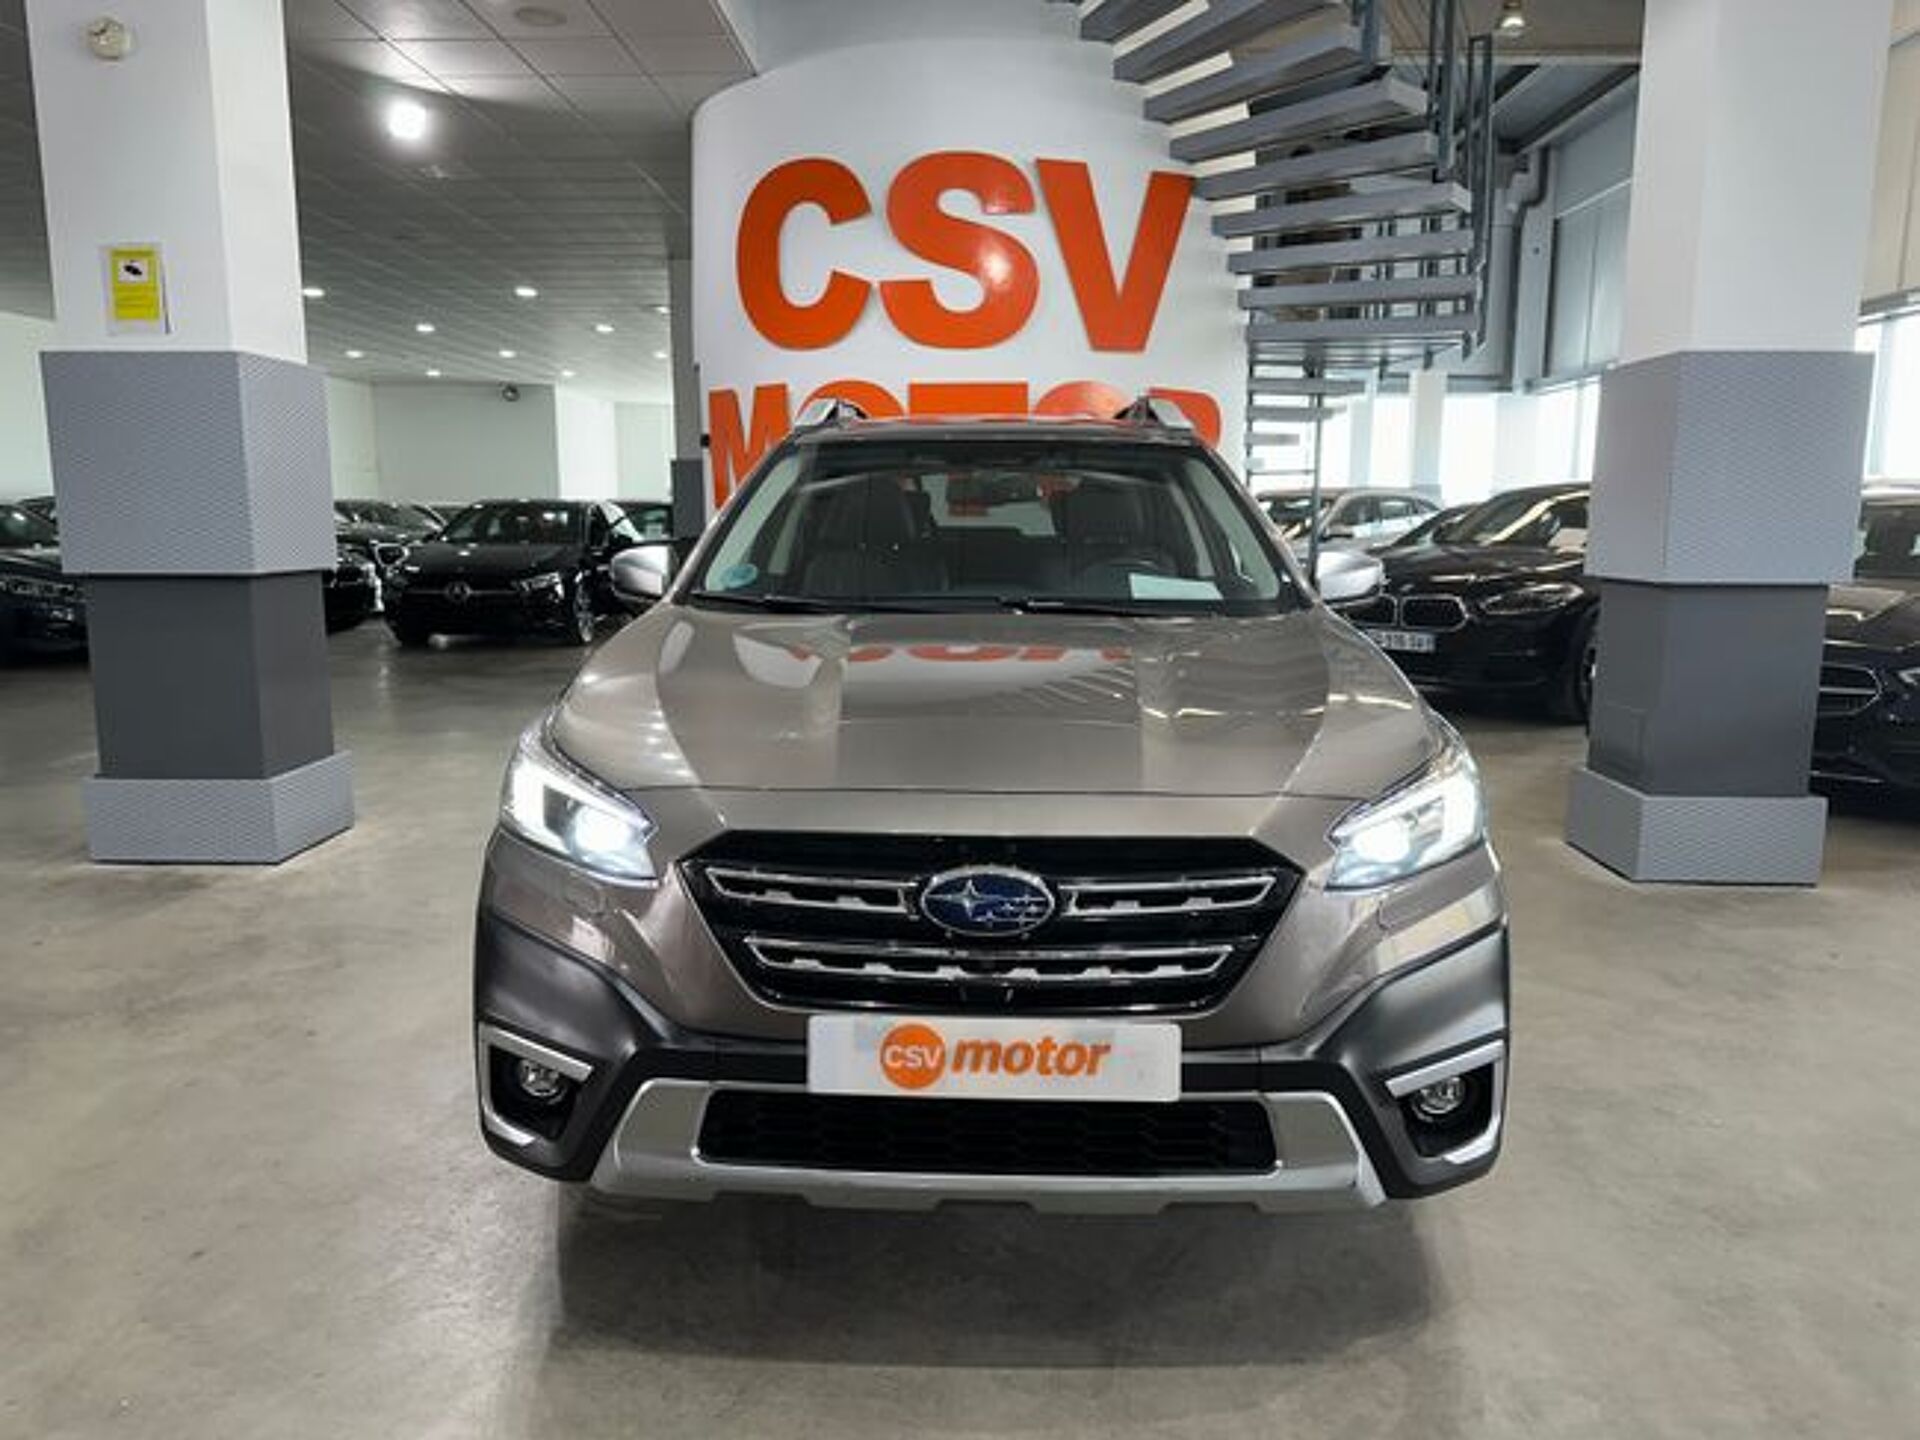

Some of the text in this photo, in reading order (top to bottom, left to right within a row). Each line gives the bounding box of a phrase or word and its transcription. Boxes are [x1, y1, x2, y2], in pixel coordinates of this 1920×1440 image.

[737, 151, 1194, 352] CSV
[884, 1036, 1111, 1076] CSV motor
